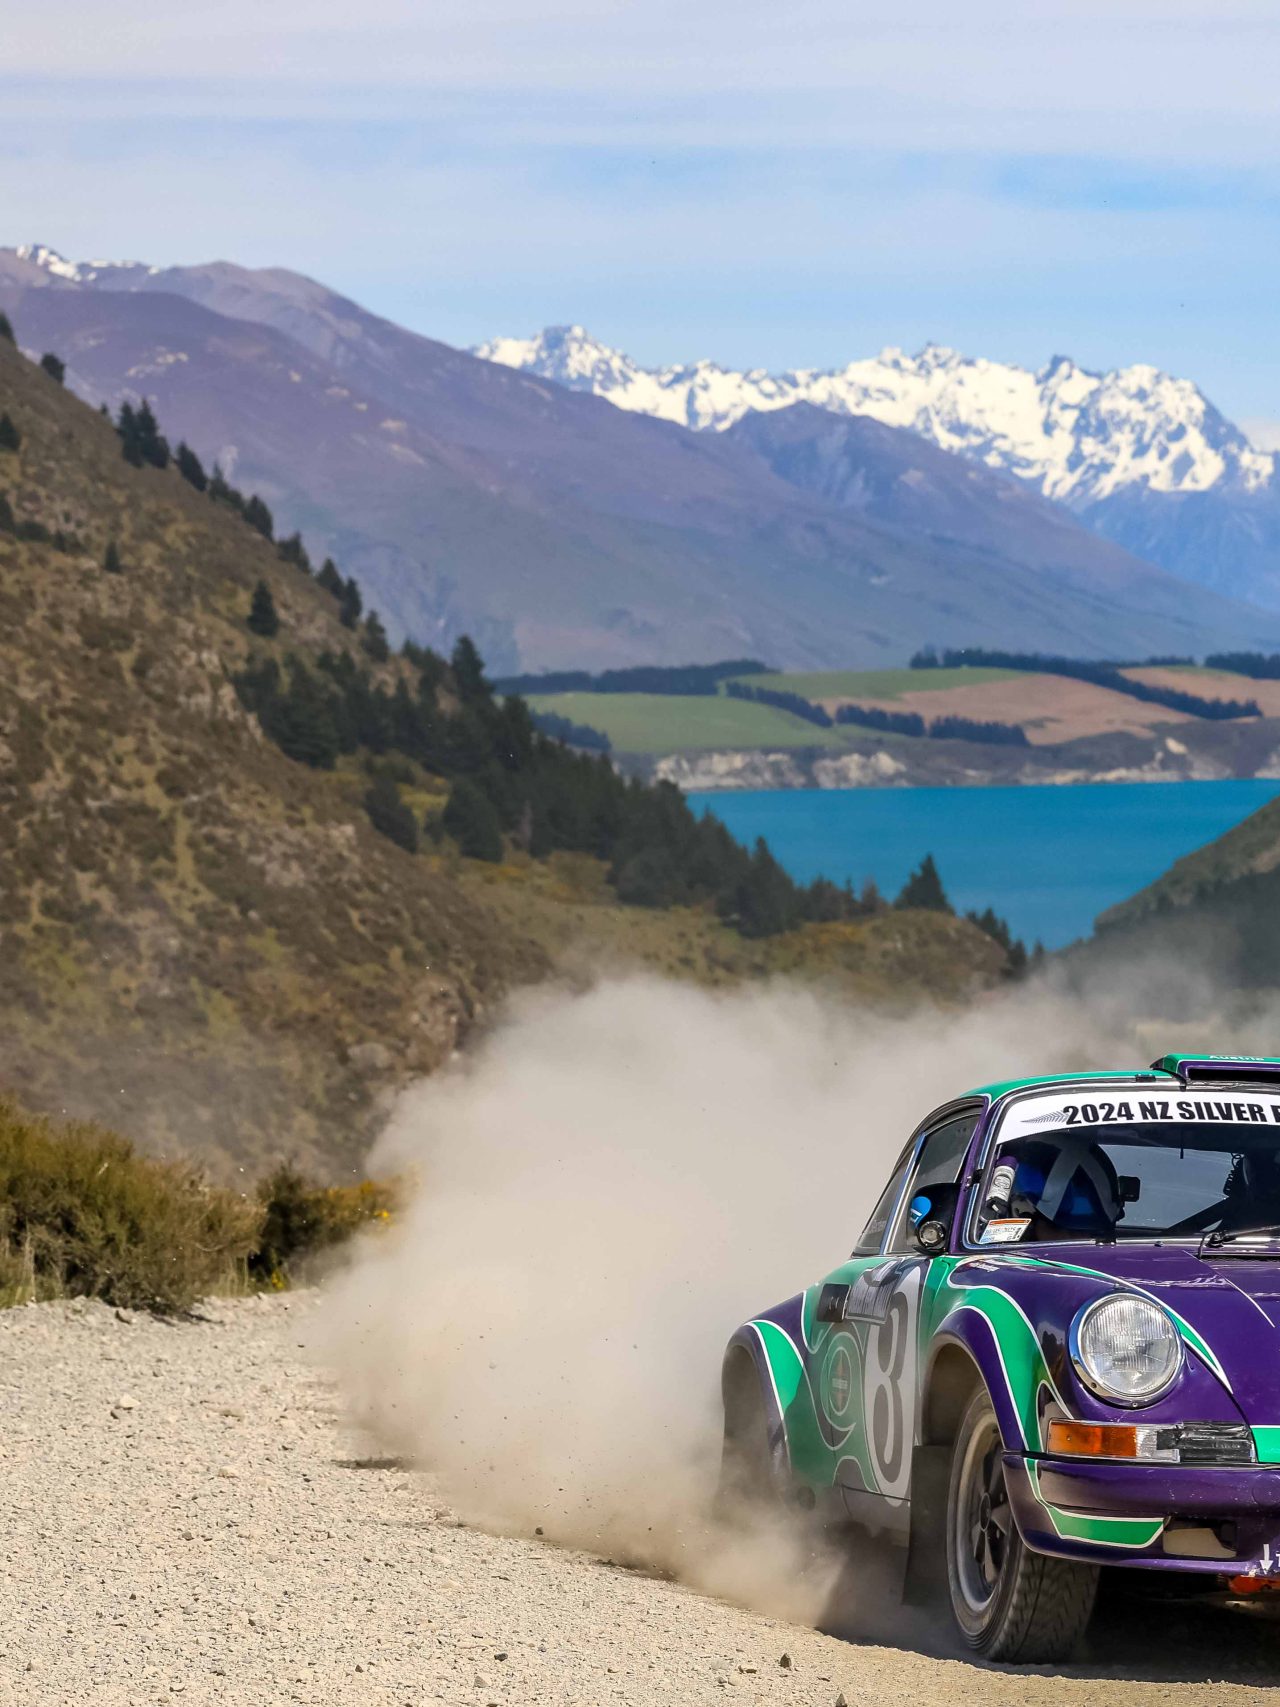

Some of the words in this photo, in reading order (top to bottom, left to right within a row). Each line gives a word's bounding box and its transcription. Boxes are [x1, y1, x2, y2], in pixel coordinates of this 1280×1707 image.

[1063, 1103, 1134, 1125] 2024
[1140, 1102, 1173, 1120] NZ
[1179, 1101, 1268, 1123] SILVER
[873, 1291, 908, 1483] 3
